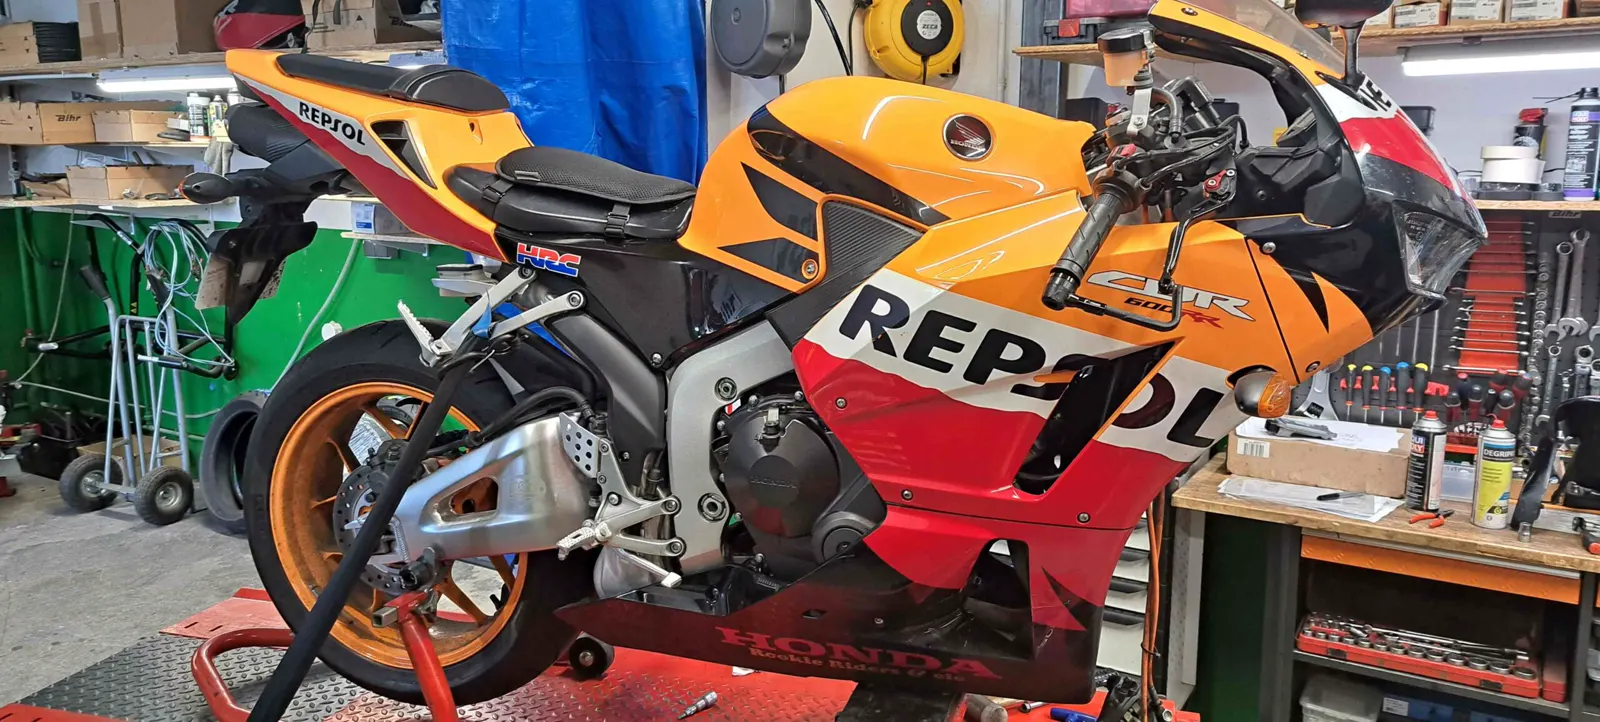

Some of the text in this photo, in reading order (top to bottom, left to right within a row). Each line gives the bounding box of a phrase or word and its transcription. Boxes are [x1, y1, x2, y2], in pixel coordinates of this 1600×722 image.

[55, 114, 81, 122] Bihr
[298, 101, 367, 146] REPSOL
[516, 242, 581, 277] HRC
[1086, 269, 1256, 322] CBR
[749, 475, 797, 489] HONDA
[714, 626, 1002, 680] HONDA
[749, 647, 824, 667] Rookie
[829, 660, 900, 675] Riders
[908, 667, 926, 677] &
